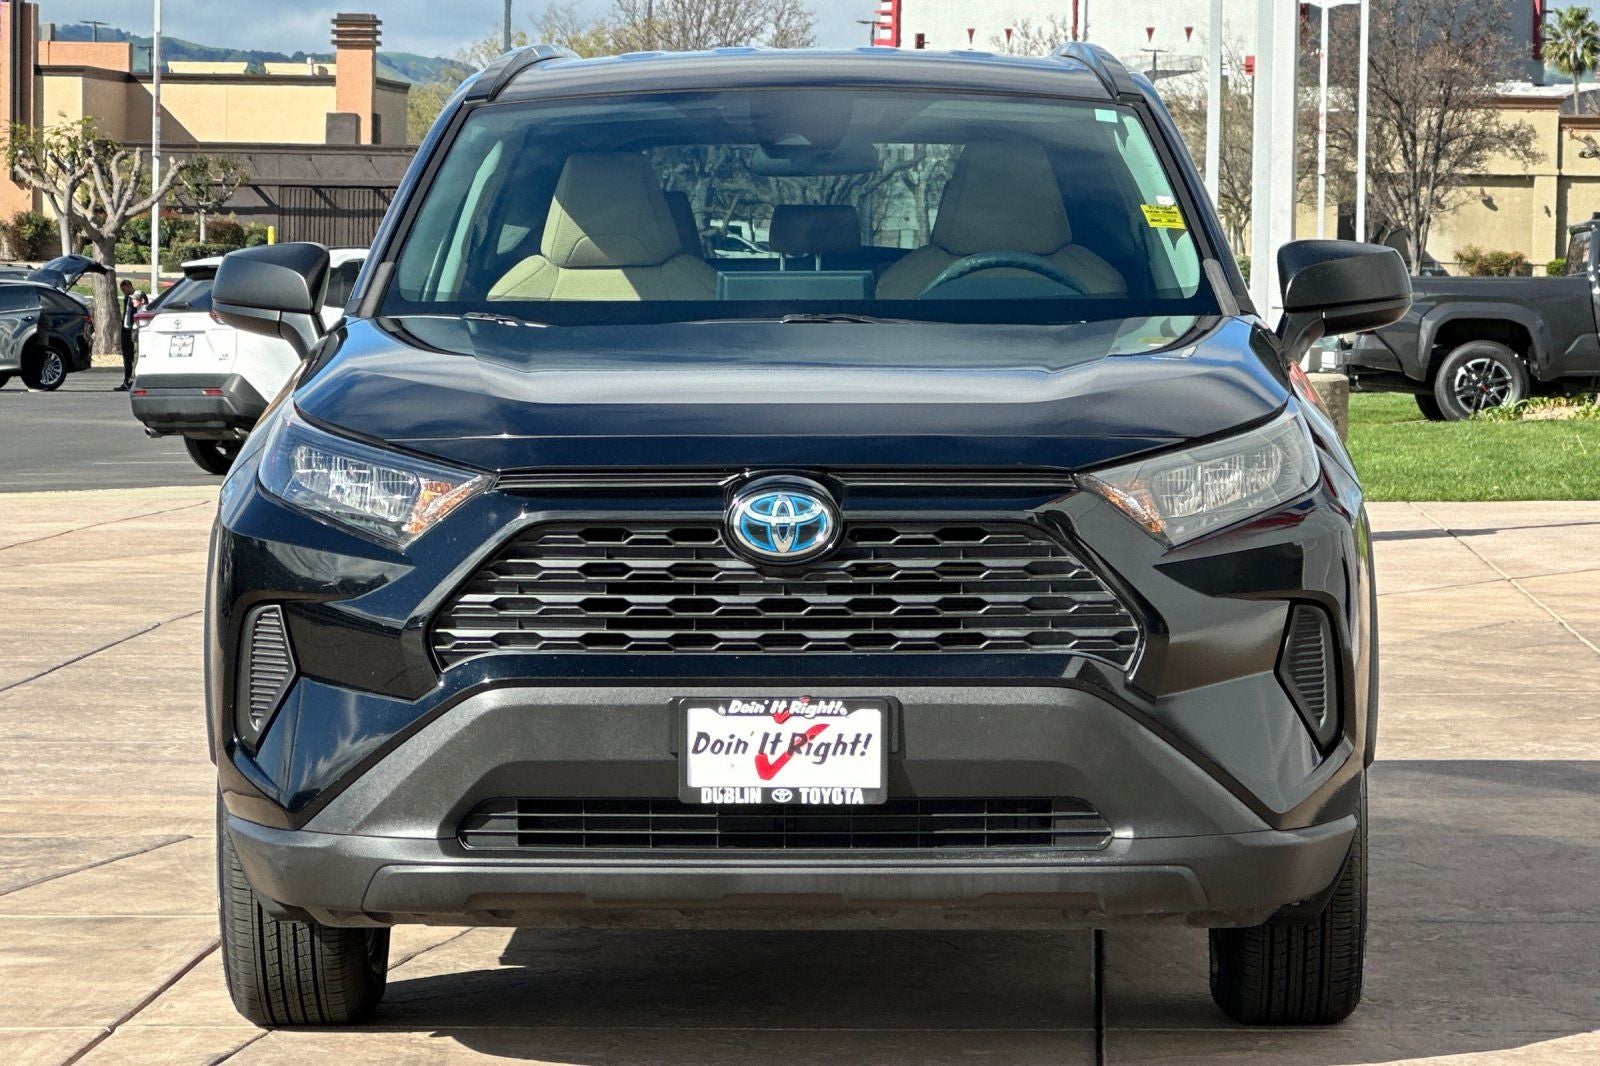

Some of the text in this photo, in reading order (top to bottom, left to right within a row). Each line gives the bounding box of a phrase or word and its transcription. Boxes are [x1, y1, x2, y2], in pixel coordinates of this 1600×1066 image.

[728, 700, 843, 719] Doin' It Right!
[691, 731, 872, 765] Doin' It Right!
[701, 788, 864, 804] DUBLIN TOYOTA
